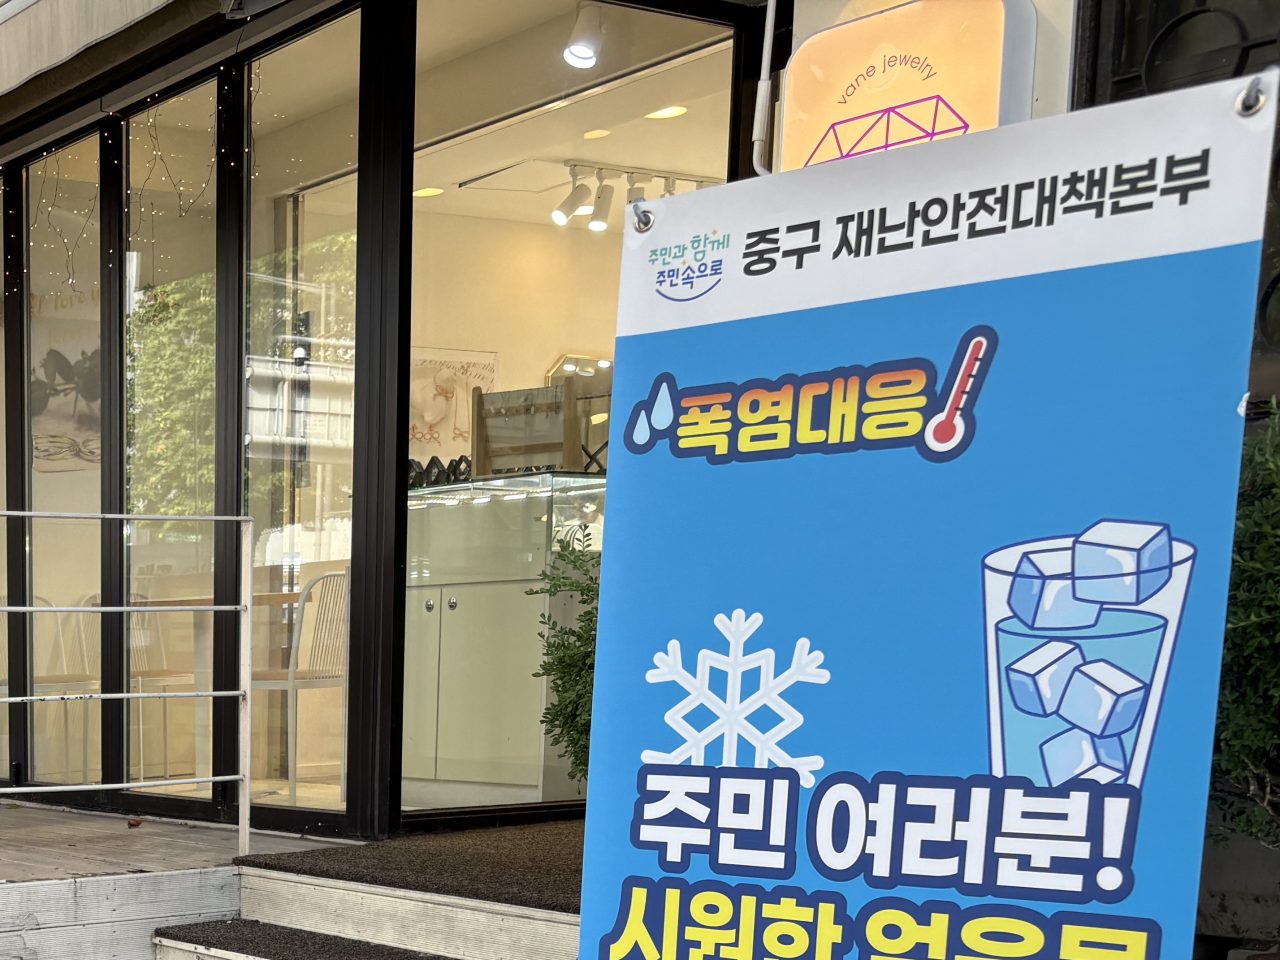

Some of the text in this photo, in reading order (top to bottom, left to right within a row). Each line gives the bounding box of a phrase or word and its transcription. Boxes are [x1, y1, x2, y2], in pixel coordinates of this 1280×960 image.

[837, 54, 938, 104] vane jewelry
[648, 233, 730, 266] 주민과 함께
[741, 148, 1211, 276] 중구 재난안전대책본부
[677, 369, 927, 455] 폭염대응
[638, 774, 1131, 891] 주민 여러분!
